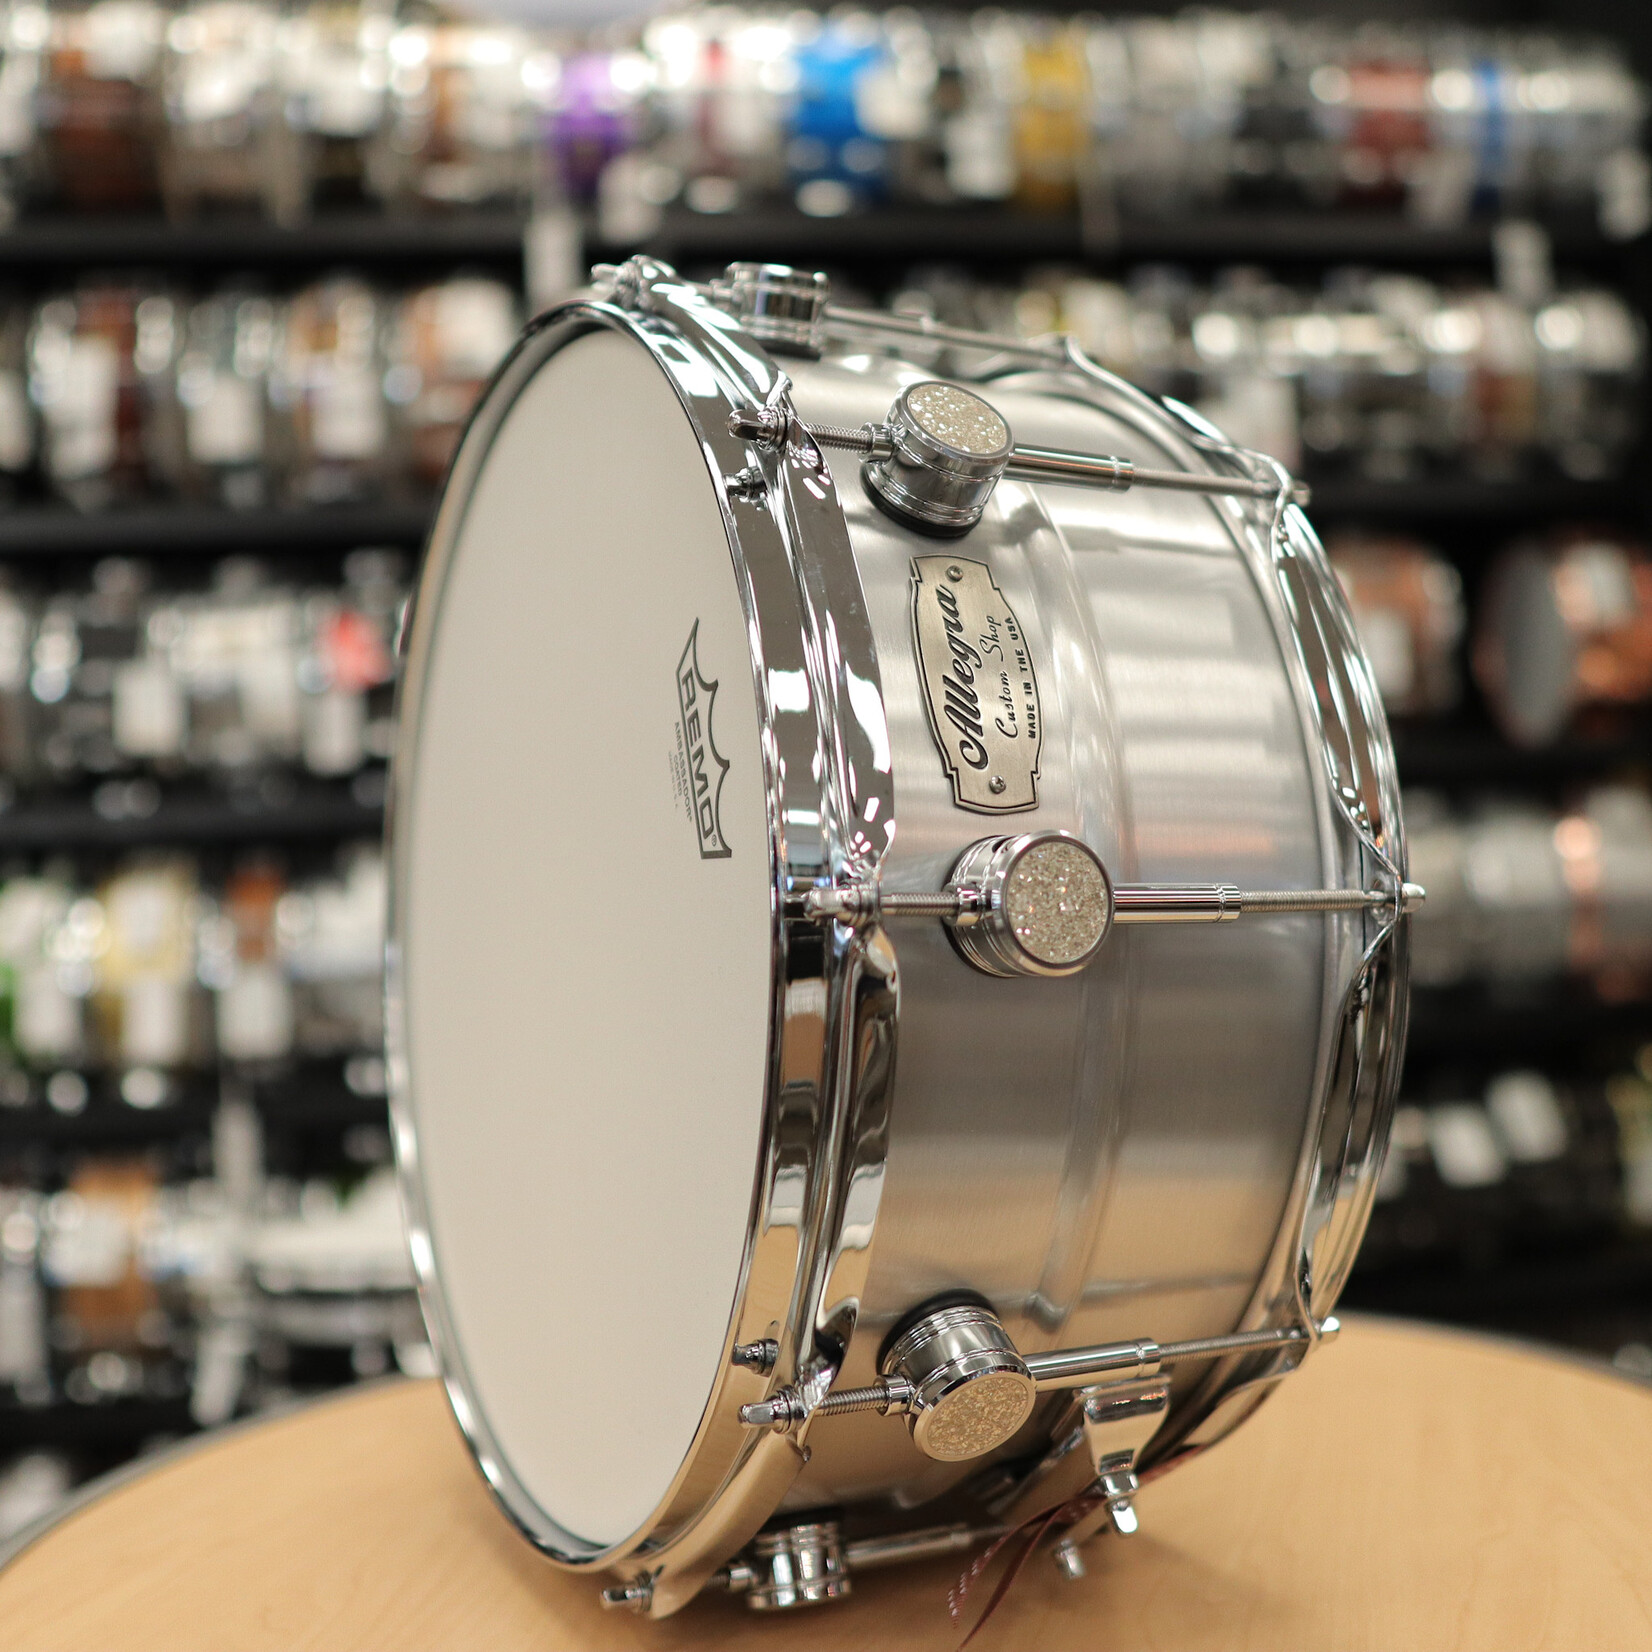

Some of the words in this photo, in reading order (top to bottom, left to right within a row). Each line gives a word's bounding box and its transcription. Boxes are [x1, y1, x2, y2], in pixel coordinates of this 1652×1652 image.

[979, 615, 1003, 662] Shop
[1004, 617, 1020, 641] USA
[936, 584, 989, 770] Allegra
[1017, 648, 1029, 673] THE
[995, 670, 1018, 739] Custom
[1023, 681, 1033, 696] IN
[1027, 704, 1037, 740] MADE
[683, 667, 714, 840] REMO
[673, 754, 682, 796] COATED
